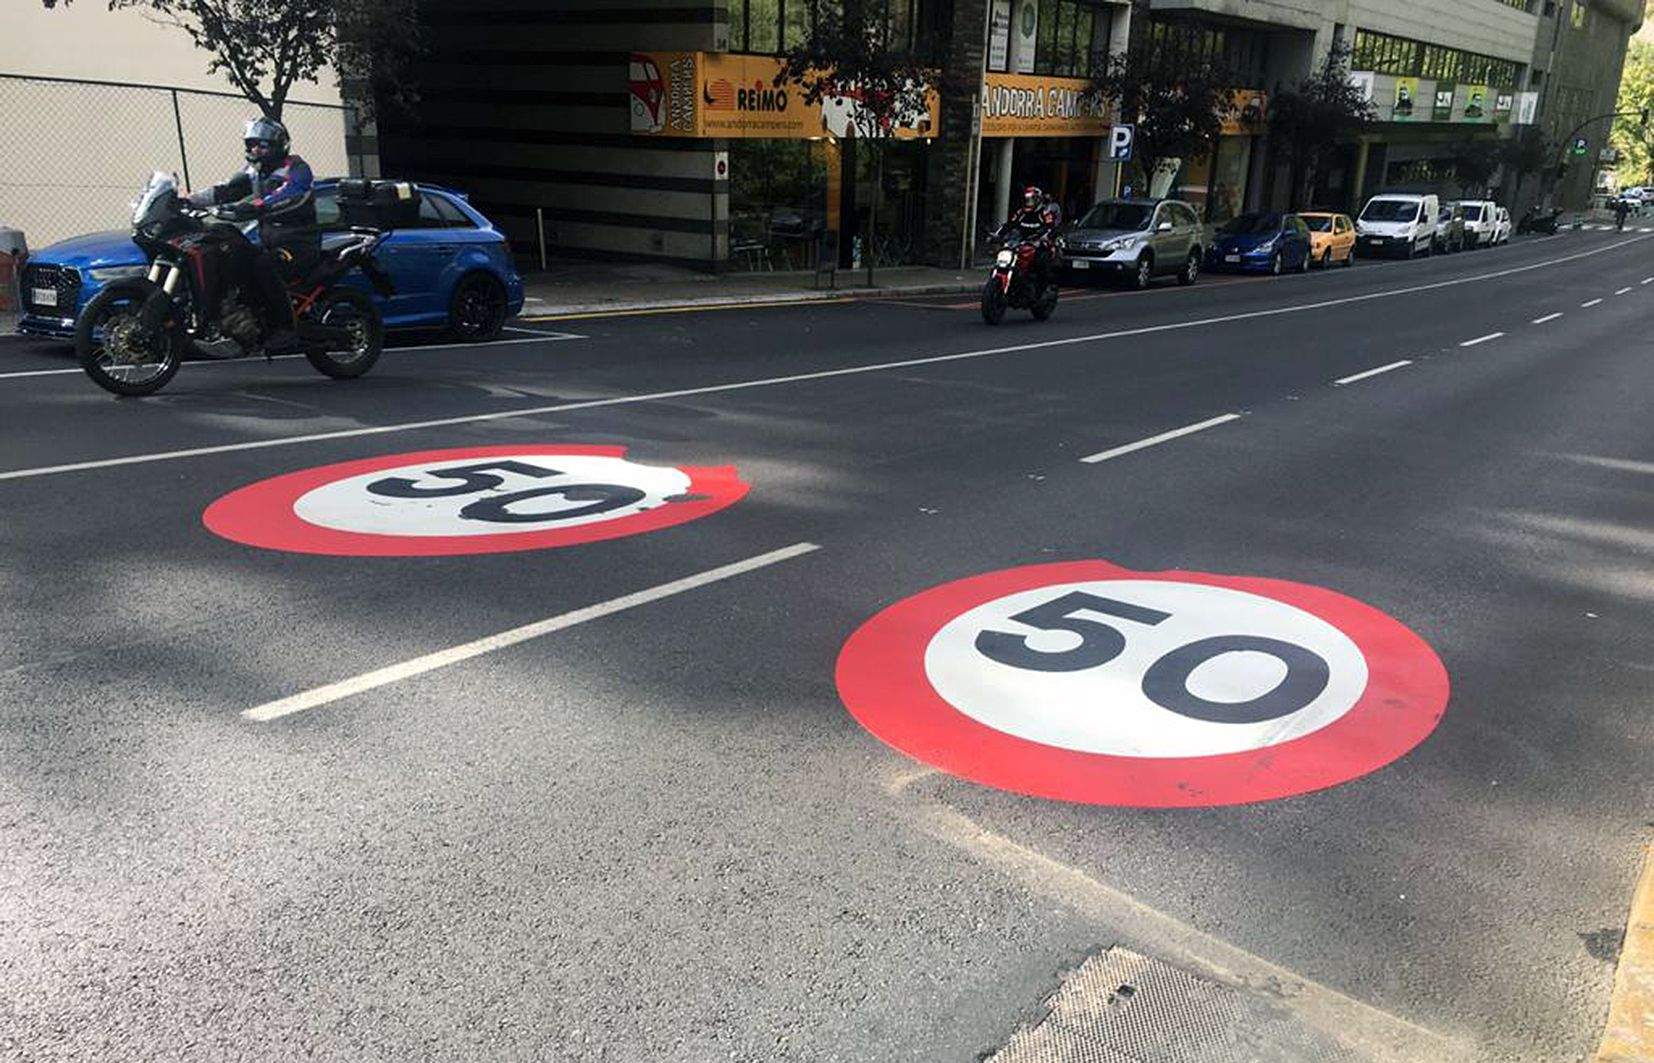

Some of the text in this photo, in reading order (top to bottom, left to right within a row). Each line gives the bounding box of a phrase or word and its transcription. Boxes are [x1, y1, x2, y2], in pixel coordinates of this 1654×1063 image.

[670, 61, 682, 130] ANDORRA
[682, 57, 694, 131] CAMPERS
[981, 82, 1106, 118] ANDORRA CAMPRS
[1110, 126, 1132, 157] P
[366, 459, 646, 523] 50
[974, 590, 1330, 724] 50
